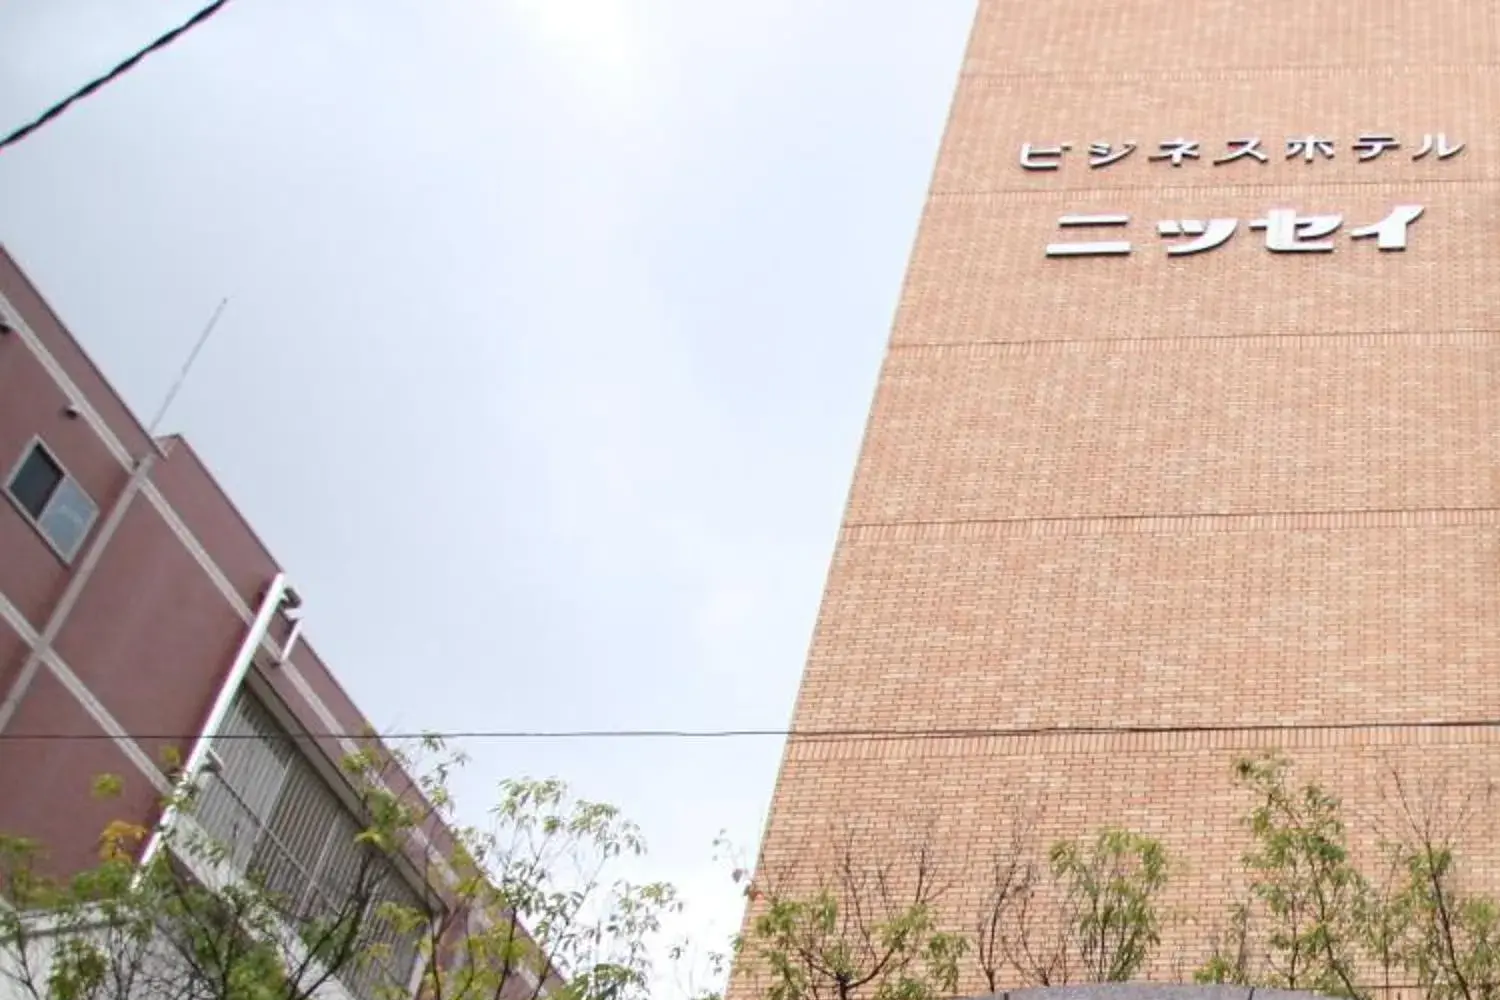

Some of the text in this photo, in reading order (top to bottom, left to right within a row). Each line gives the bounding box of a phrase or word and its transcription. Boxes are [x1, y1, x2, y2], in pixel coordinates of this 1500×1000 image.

[1019, 131, 1466, 170] ビジネスホテル
[1045, 203, 1427, 259] ニッセイ
